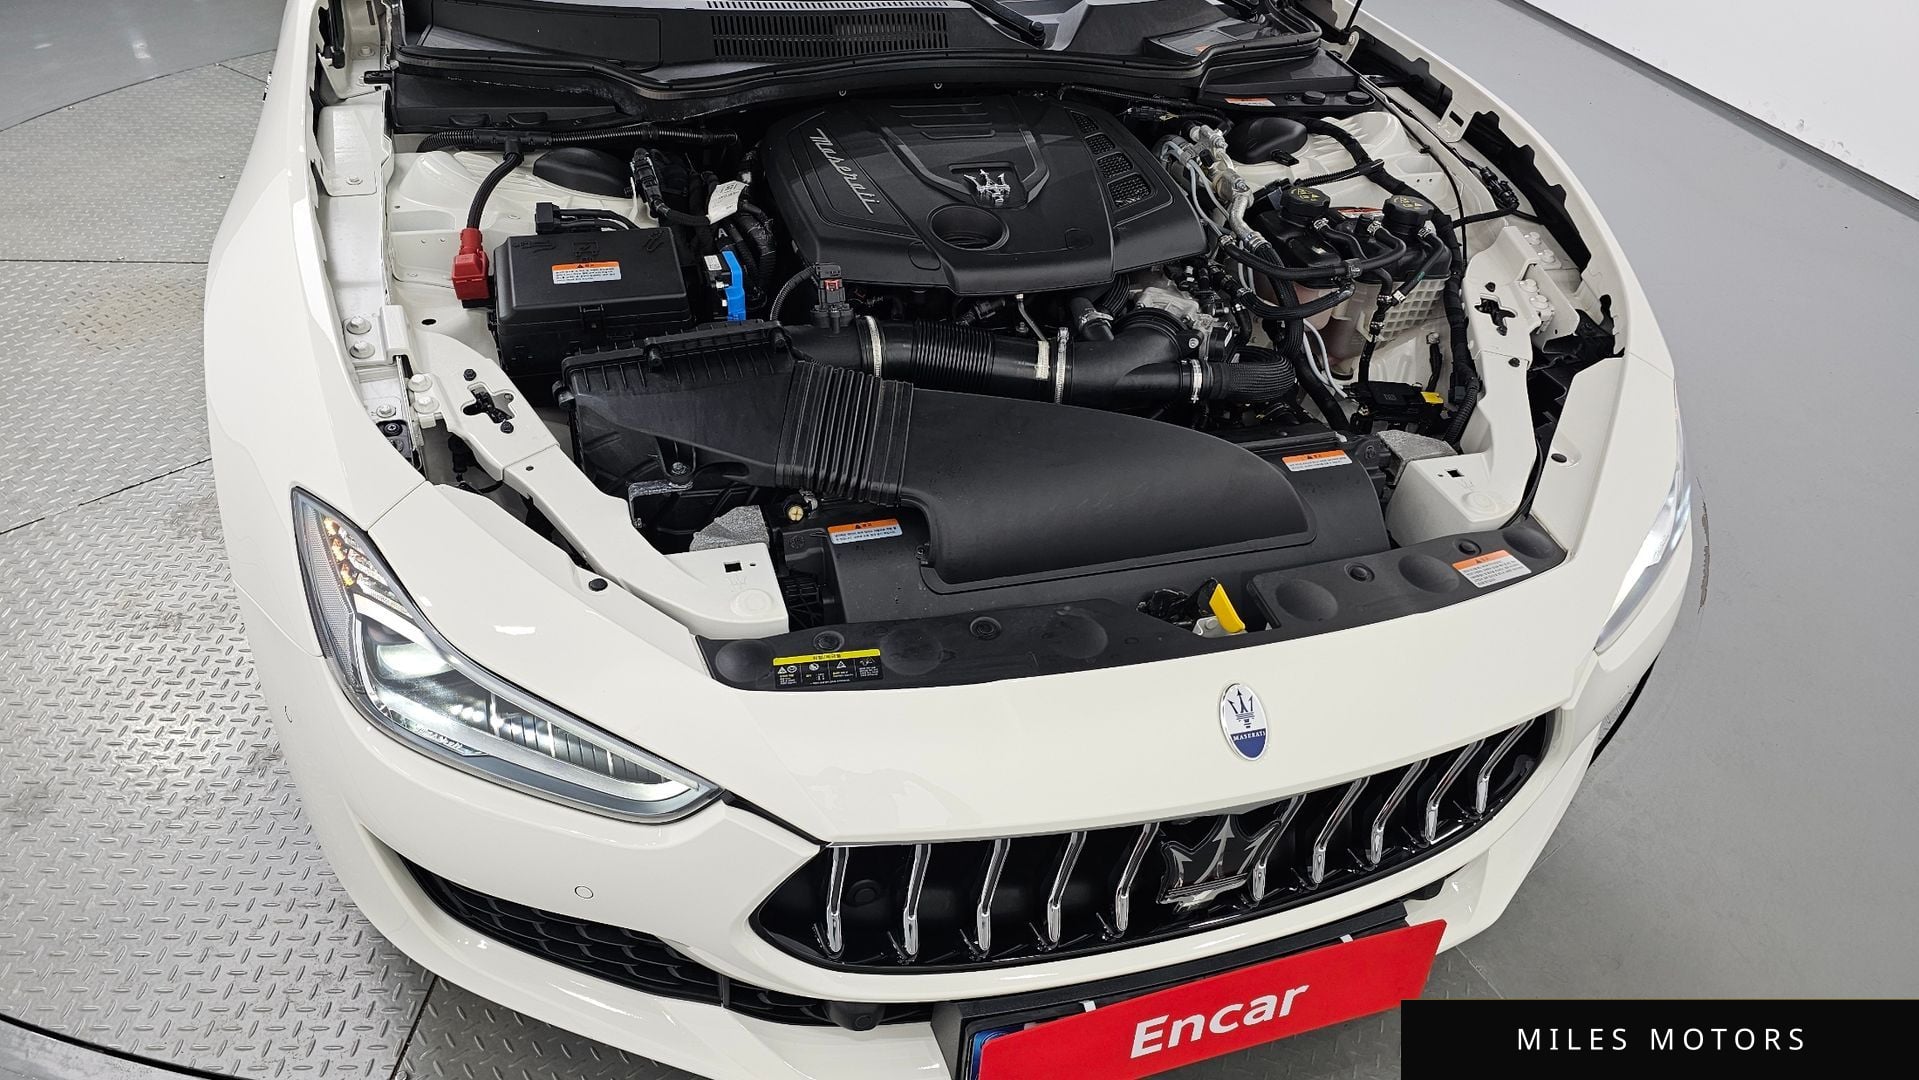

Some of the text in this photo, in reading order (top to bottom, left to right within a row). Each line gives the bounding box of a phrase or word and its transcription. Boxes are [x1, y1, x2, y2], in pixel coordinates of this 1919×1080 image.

[809, 127, 880, 214] Maserati
[1232, 730, 1266, 742] MASERATI
[1130, 984, 1310, 1059] Encar
